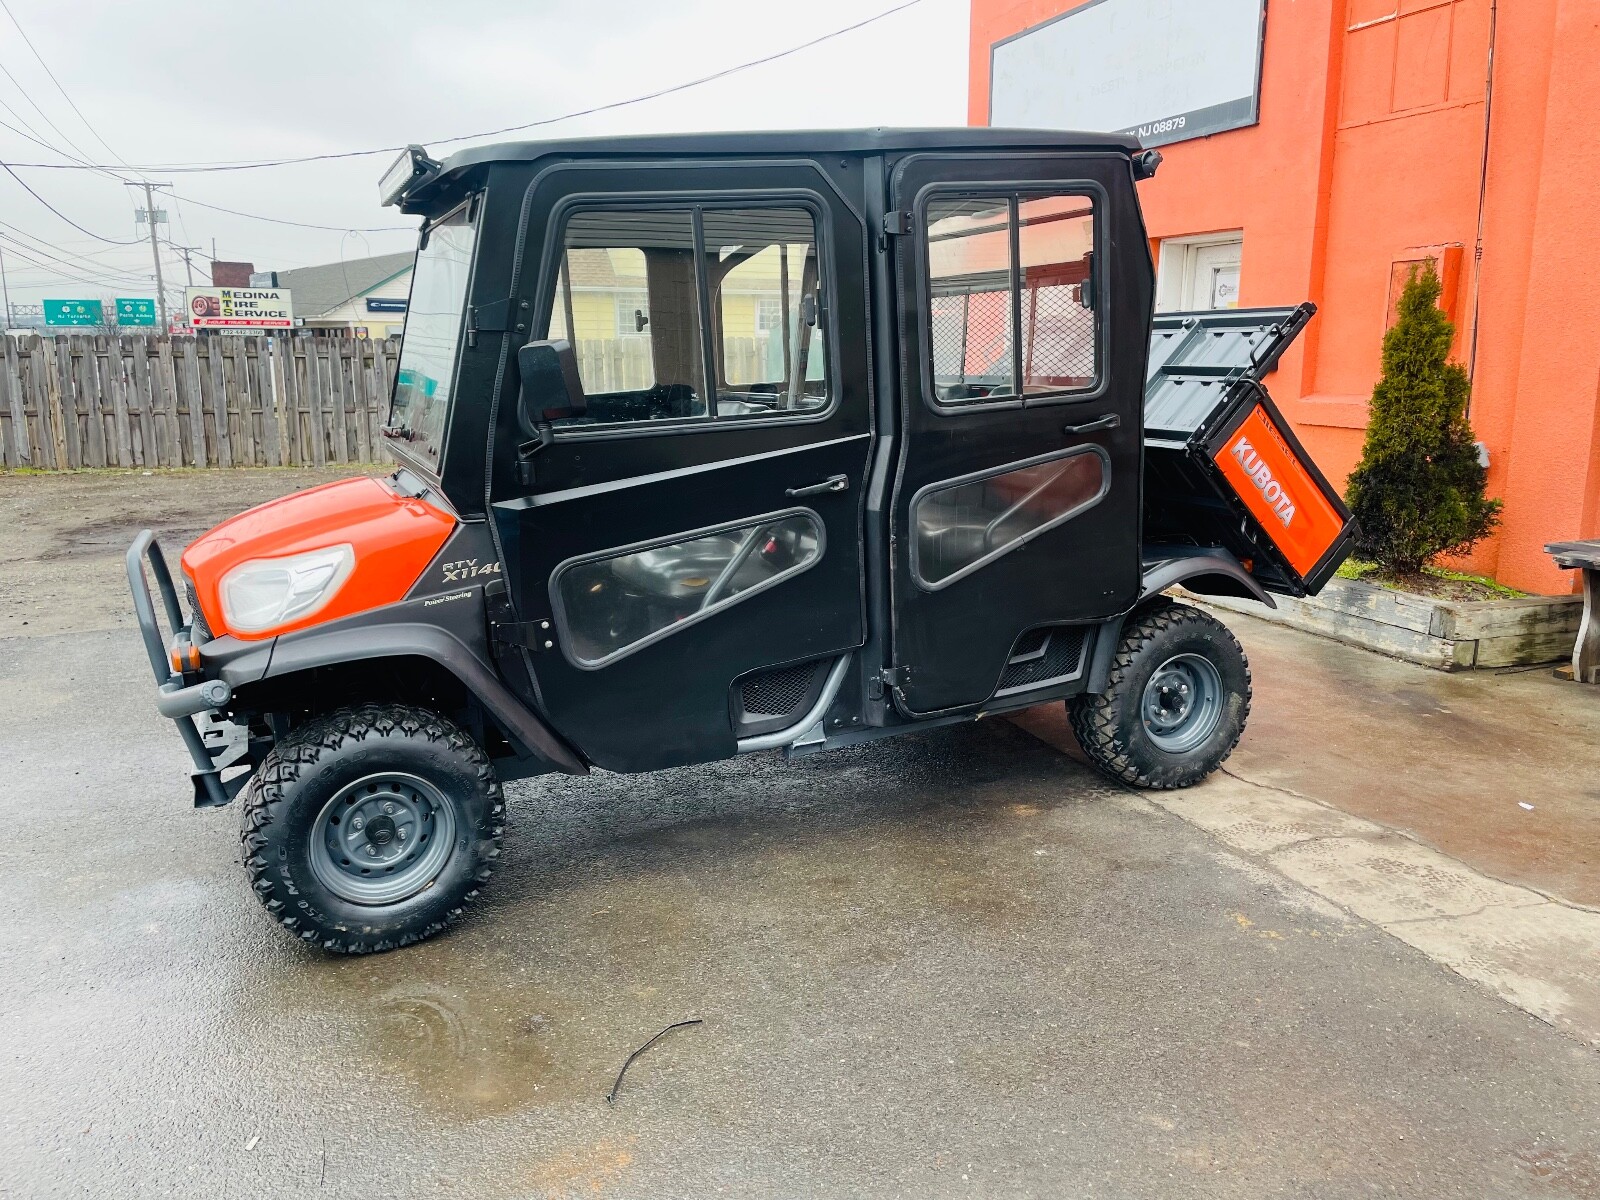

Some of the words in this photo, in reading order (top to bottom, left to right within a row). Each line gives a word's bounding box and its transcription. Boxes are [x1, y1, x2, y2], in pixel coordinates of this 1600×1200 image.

[1138, 125, 1152, 138] NJ
[1153, 116, 1186, 134] 08879
[222, 290, 280, 299] MEDINA
[223, 299, 259, 308] TIRE
[223, 308, 288, 318] SERVICE
[1230, 435, 1297, 529] KUBOTA
[442, 558, 478, 572] RTV
[423, 597, 445, 607] Power
[444, 591, 473, 602] Steering
